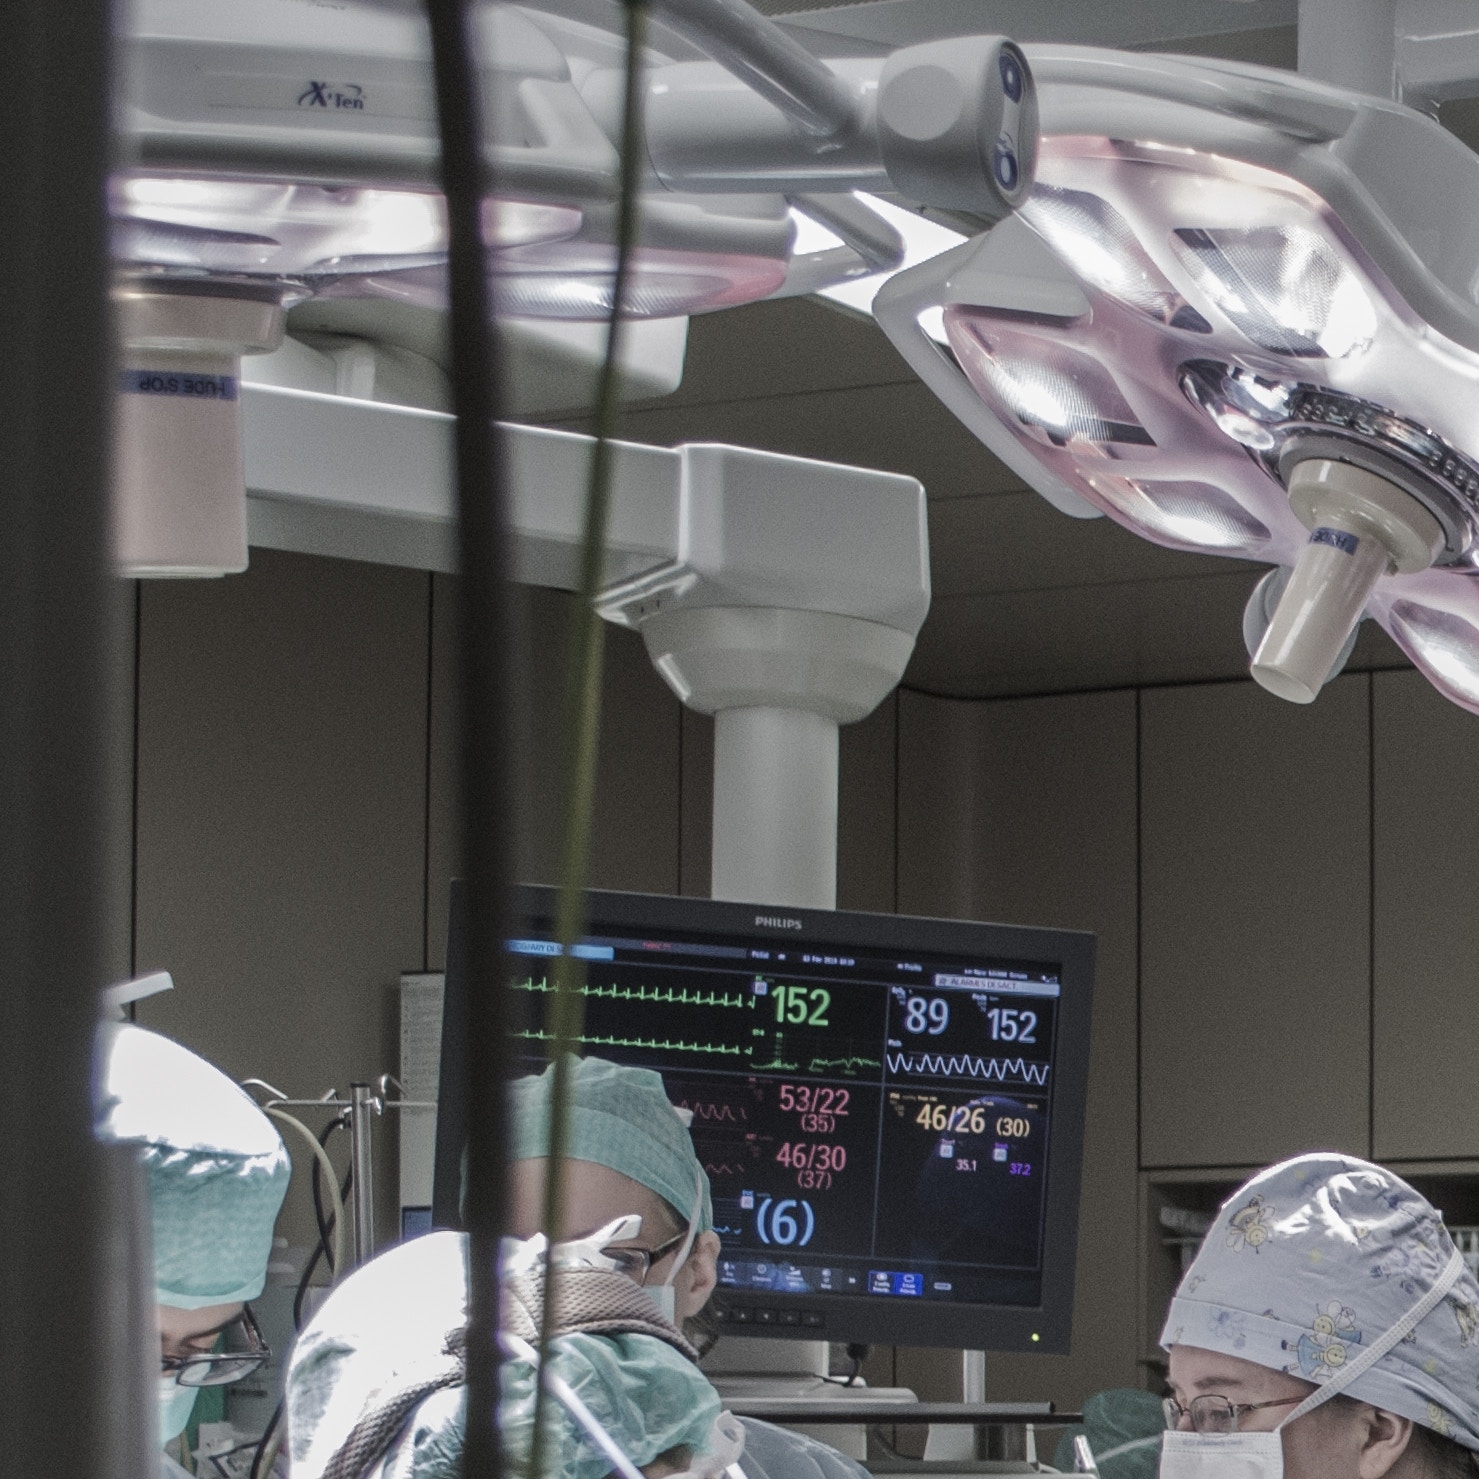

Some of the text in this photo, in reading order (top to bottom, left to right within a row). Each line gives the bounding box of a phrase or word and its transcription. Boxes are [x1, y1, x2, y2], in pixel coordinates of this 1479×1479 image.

[754, 915, 803, 930] PHILIPS
[770, 985, 831, 1027] 152
[904, 995, 950, 1036] 89
[987, 1007, 1038, 1044] 152
[779, 1083, 851, 1117] 53/22
[800, 1113, 836, 1134] (35)
[915, 1103, 1031, 1138] 46/26 (30)
[776, 1141, 847, 1172] 46/30
[955, 1158, 977, 1173] 35.1
[797, 1170, 832, 1190] (37)
[756, 1198, 816, 1247] (6)
